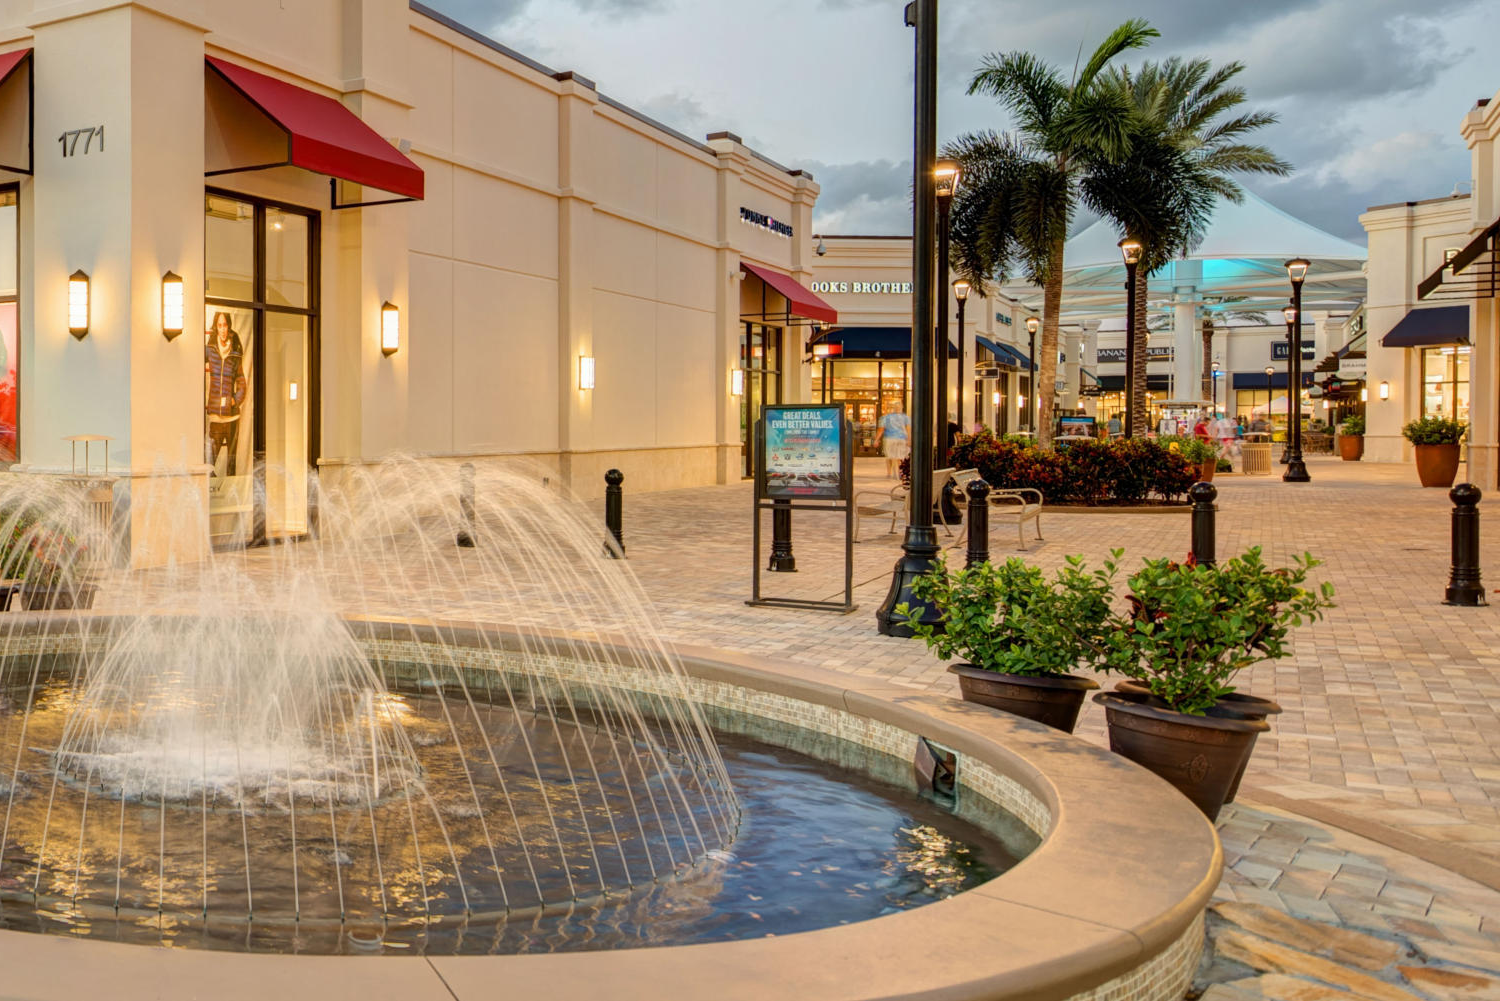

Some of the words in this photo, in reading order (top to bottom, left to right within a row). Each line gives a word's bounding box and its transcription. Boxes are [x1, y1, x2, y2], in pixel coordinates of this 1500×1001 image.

[58, 124, 104, 158] 1771
[811, 282, 848, 293] OOKS
[852, 282, 913, 294] BROTHE
[1276, 346, 1289, 355] GA
[782, 411, 801, 420] GREAT
[771, 420, 787, 429] EVEN
[787, 420, 810, 429] BETTER
